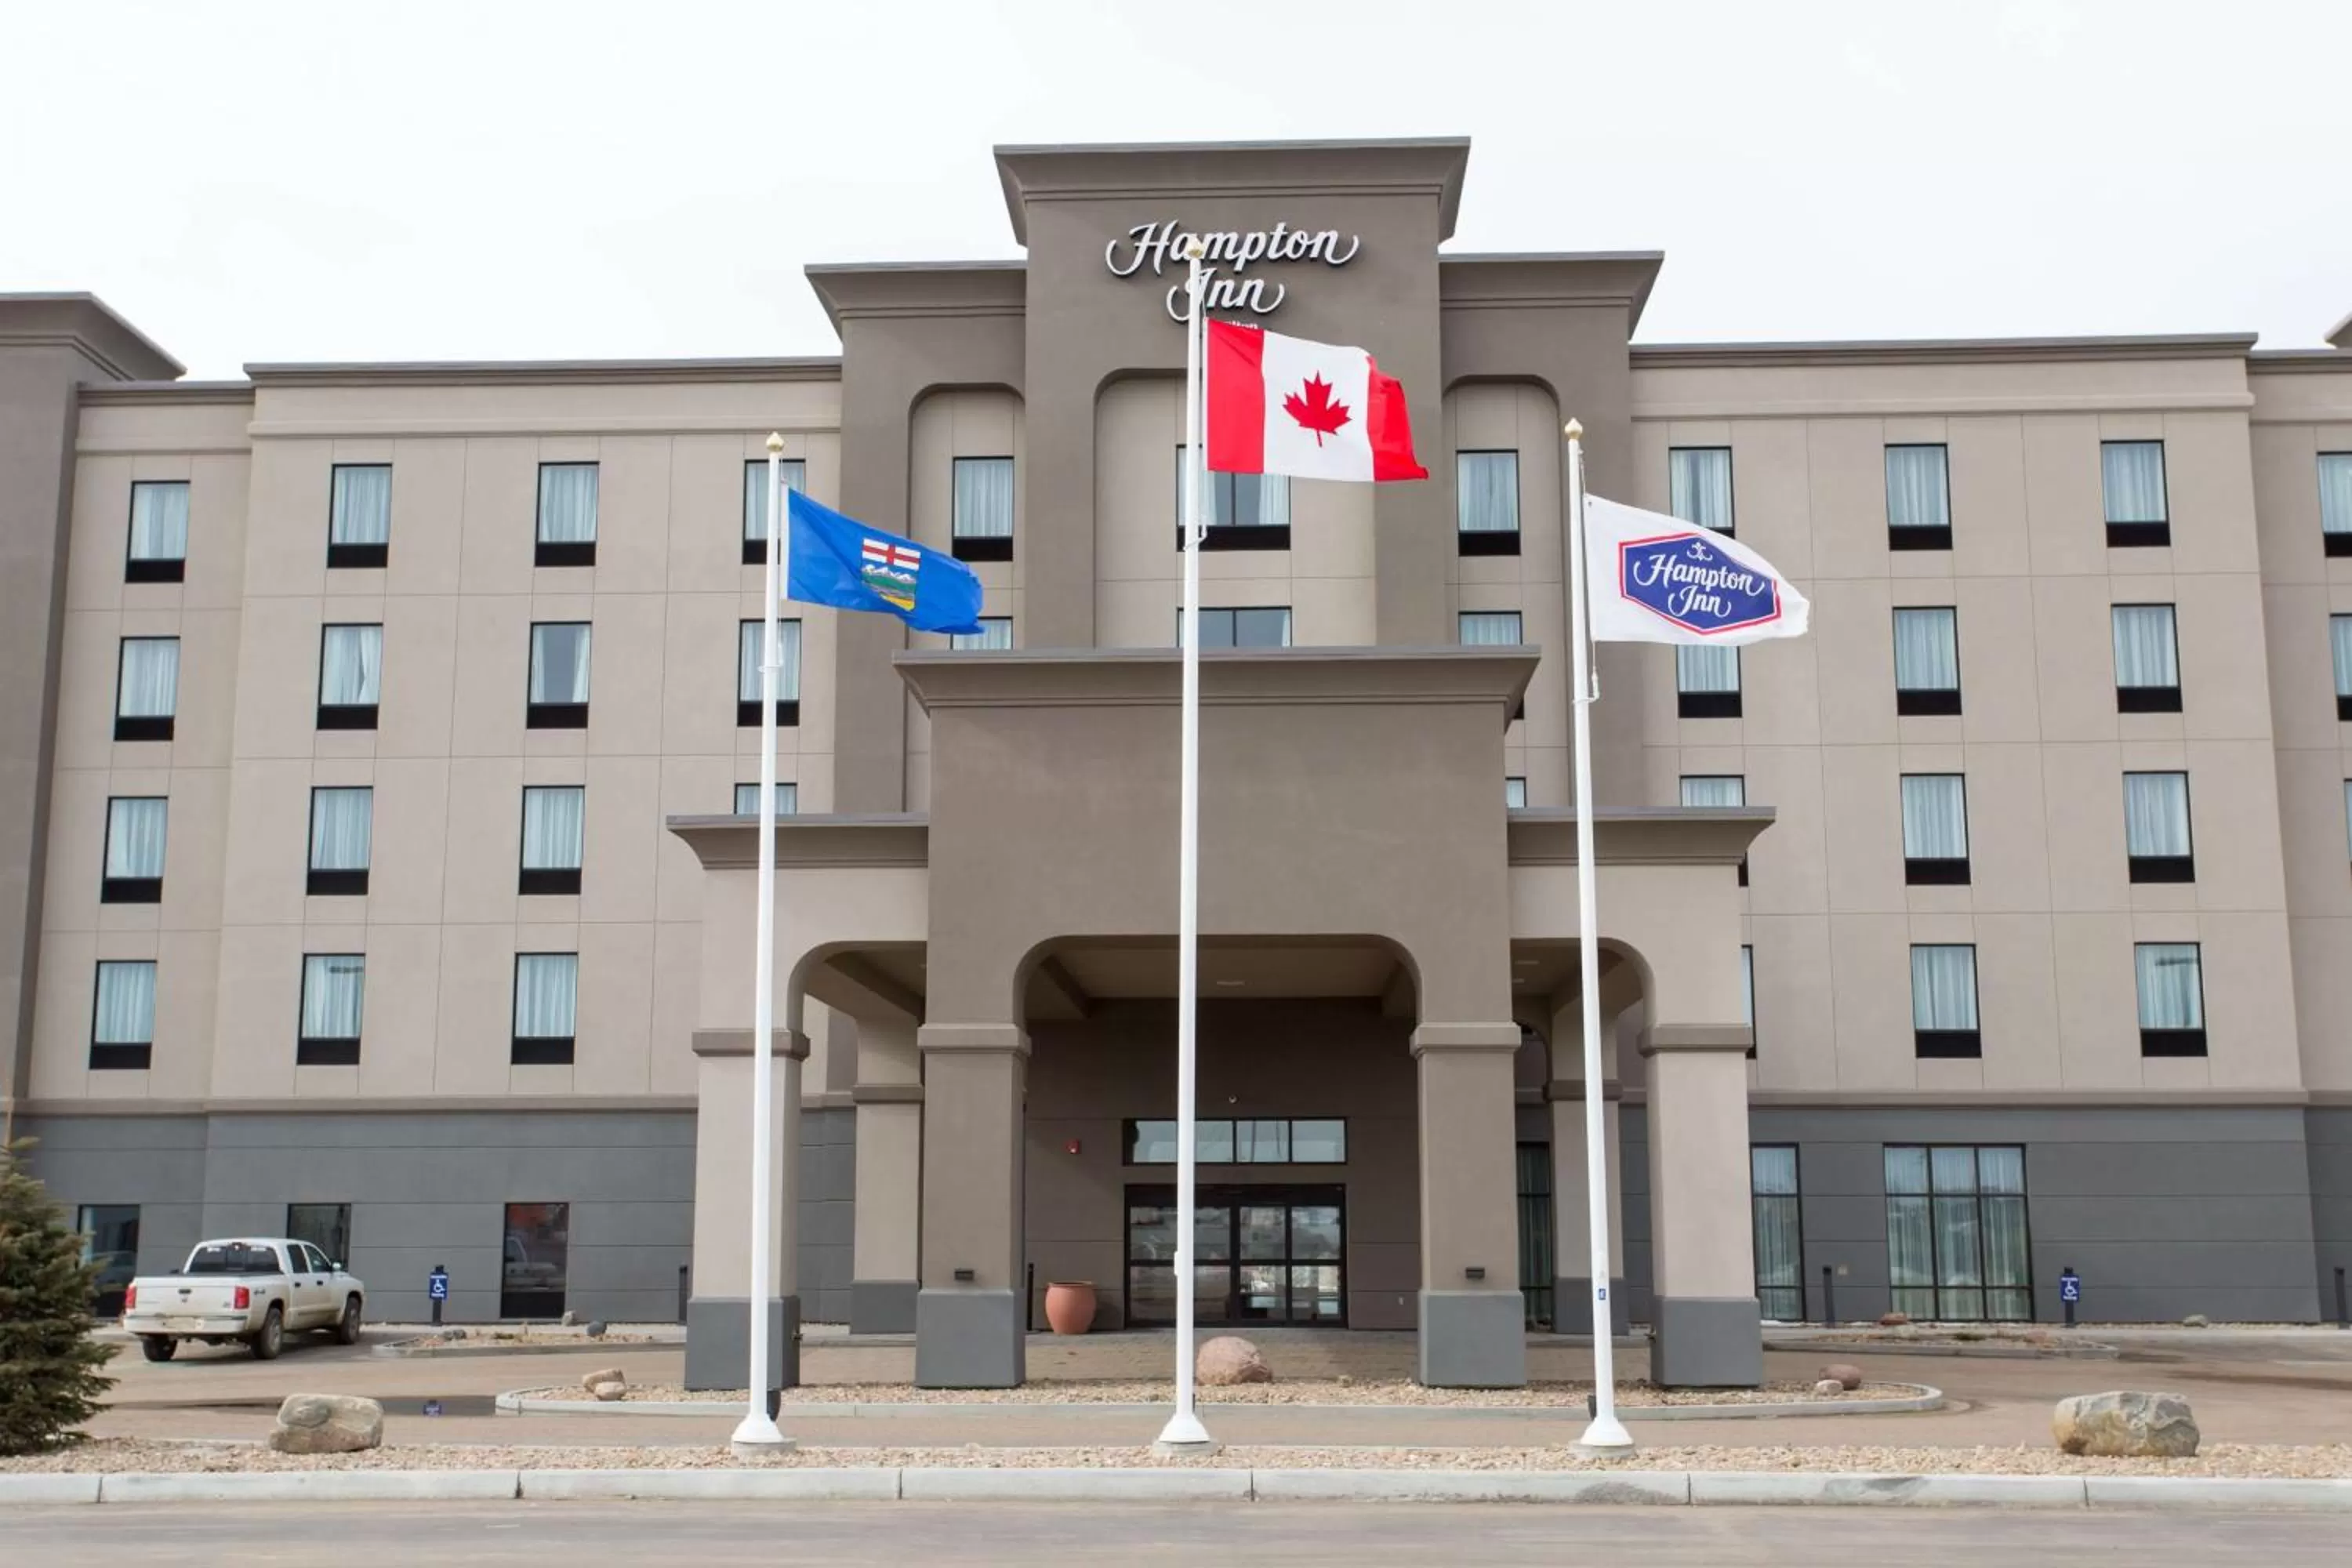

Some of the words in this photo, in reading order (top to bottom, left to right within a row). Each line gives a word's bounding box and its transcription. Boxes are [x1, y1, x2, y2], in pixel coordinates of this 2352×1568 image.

[1105, 220, 1359, 276] Hampton
[1166, 267, 1285, 321] Inn
[1633, 554, 1764, 597] Hampton
[1668, 586, 1732, 618] Inn
